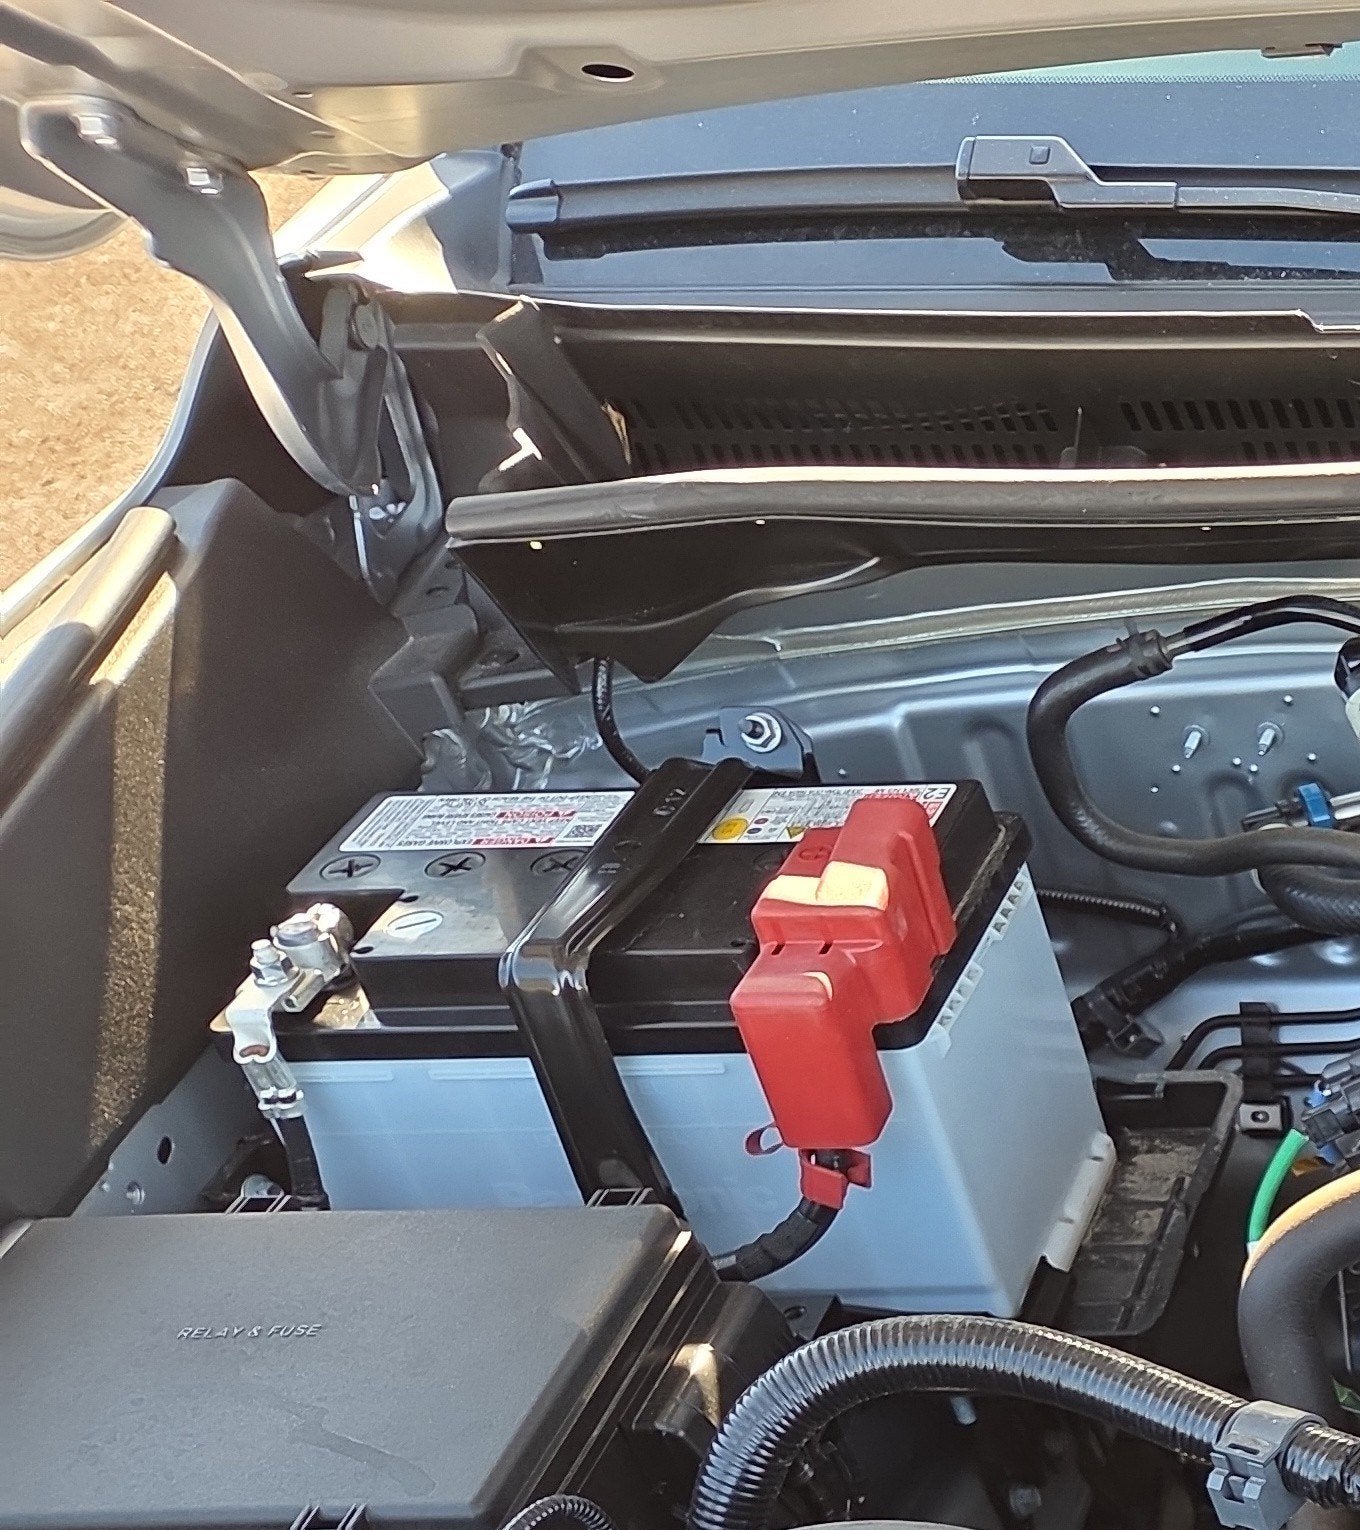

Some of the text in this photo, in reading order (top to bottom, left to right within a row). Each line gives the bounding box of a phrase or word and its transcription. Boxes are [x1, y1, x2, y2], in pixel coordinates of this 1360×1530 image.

[177, 1323, 323, 1340] RELAY & FUSE
